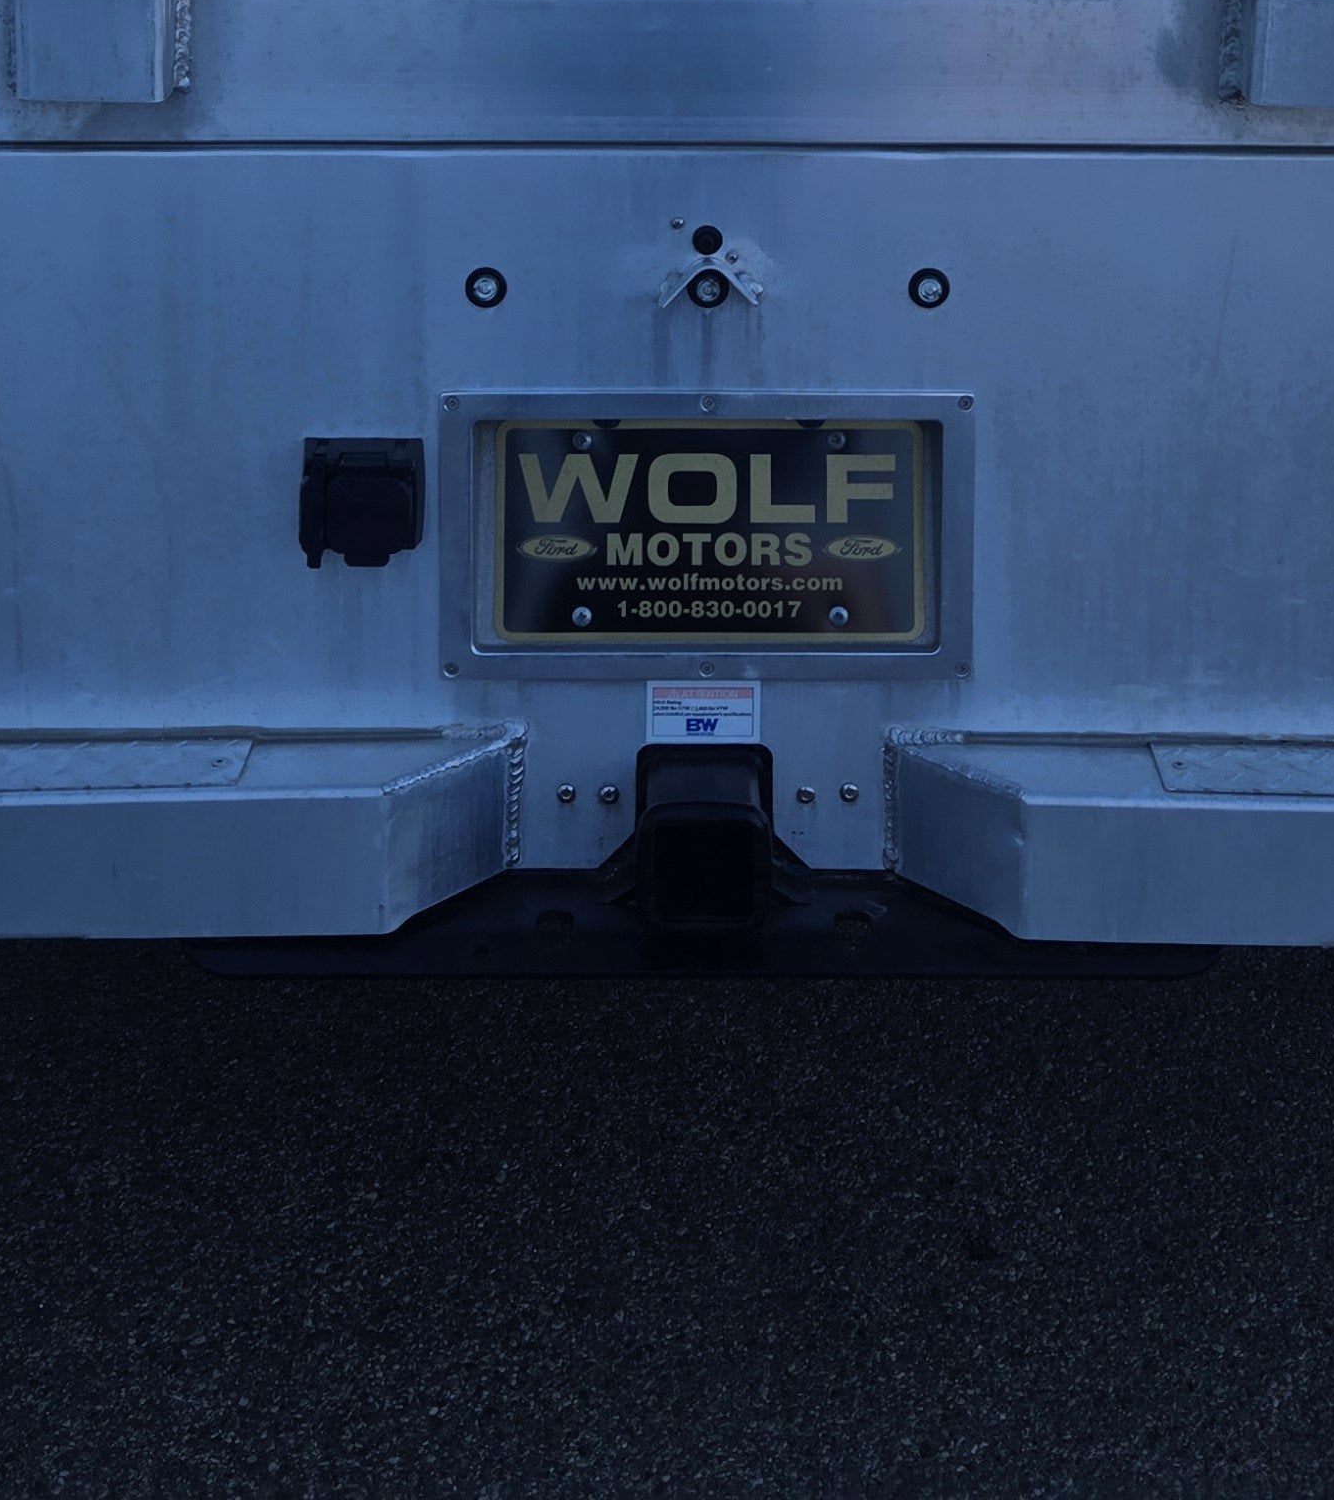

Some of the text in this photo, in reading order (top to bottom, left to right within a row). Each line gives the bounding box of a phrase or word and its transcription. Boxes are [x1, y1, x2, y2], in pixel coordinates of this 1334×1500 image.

[518, 452, 897, 525] WOLF
[533, 538, 578, 557] Ford
[606, 532, 813, 567] MOTORS
[838, 538, 884, 557] Ford
[576, 573, 844, 592] www.wolfmotors.com
[617, 600, 802, 619] 1-800-830-0017
[681, 688, 739, 698] ATTENTION
